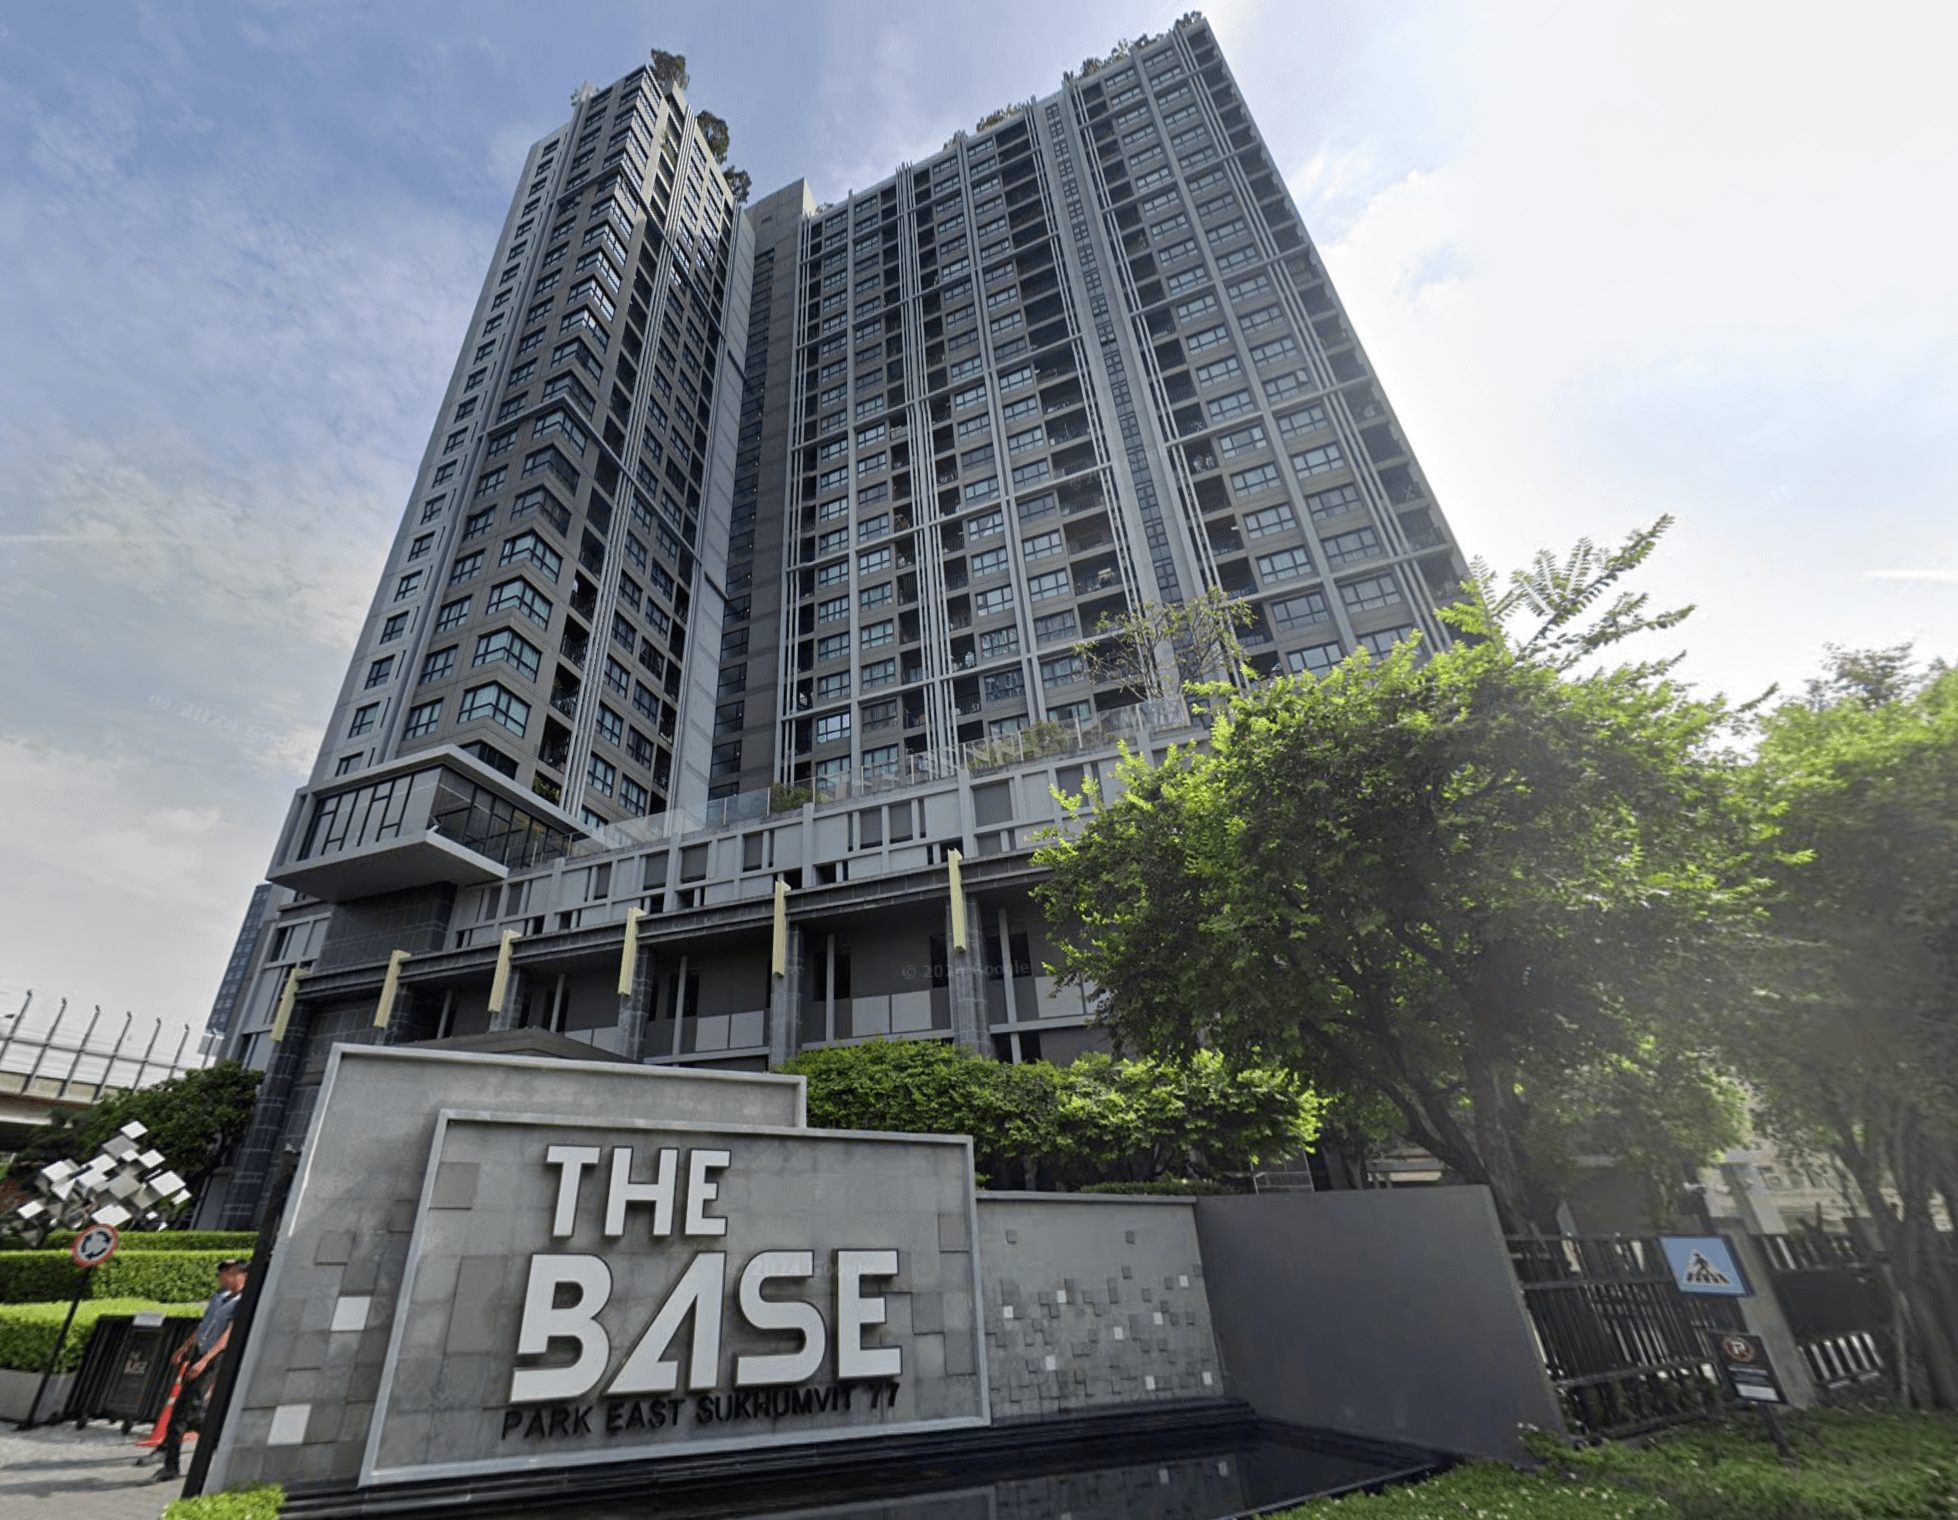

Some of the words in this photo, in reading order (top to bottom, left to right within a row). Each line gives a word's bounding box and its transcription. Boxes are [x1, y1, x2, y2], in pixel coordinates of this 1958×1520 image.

[545, 1144, 732, 1237] THE
[509, 1249, 902, 1403] BASE
[501, 1405, 595, 1440] PARK
[605, 1398, 686, 1432] EAST
[695, 1384, 857, 1424] SUKHUMVIT
[868, 1382, 900, 1409] 77
